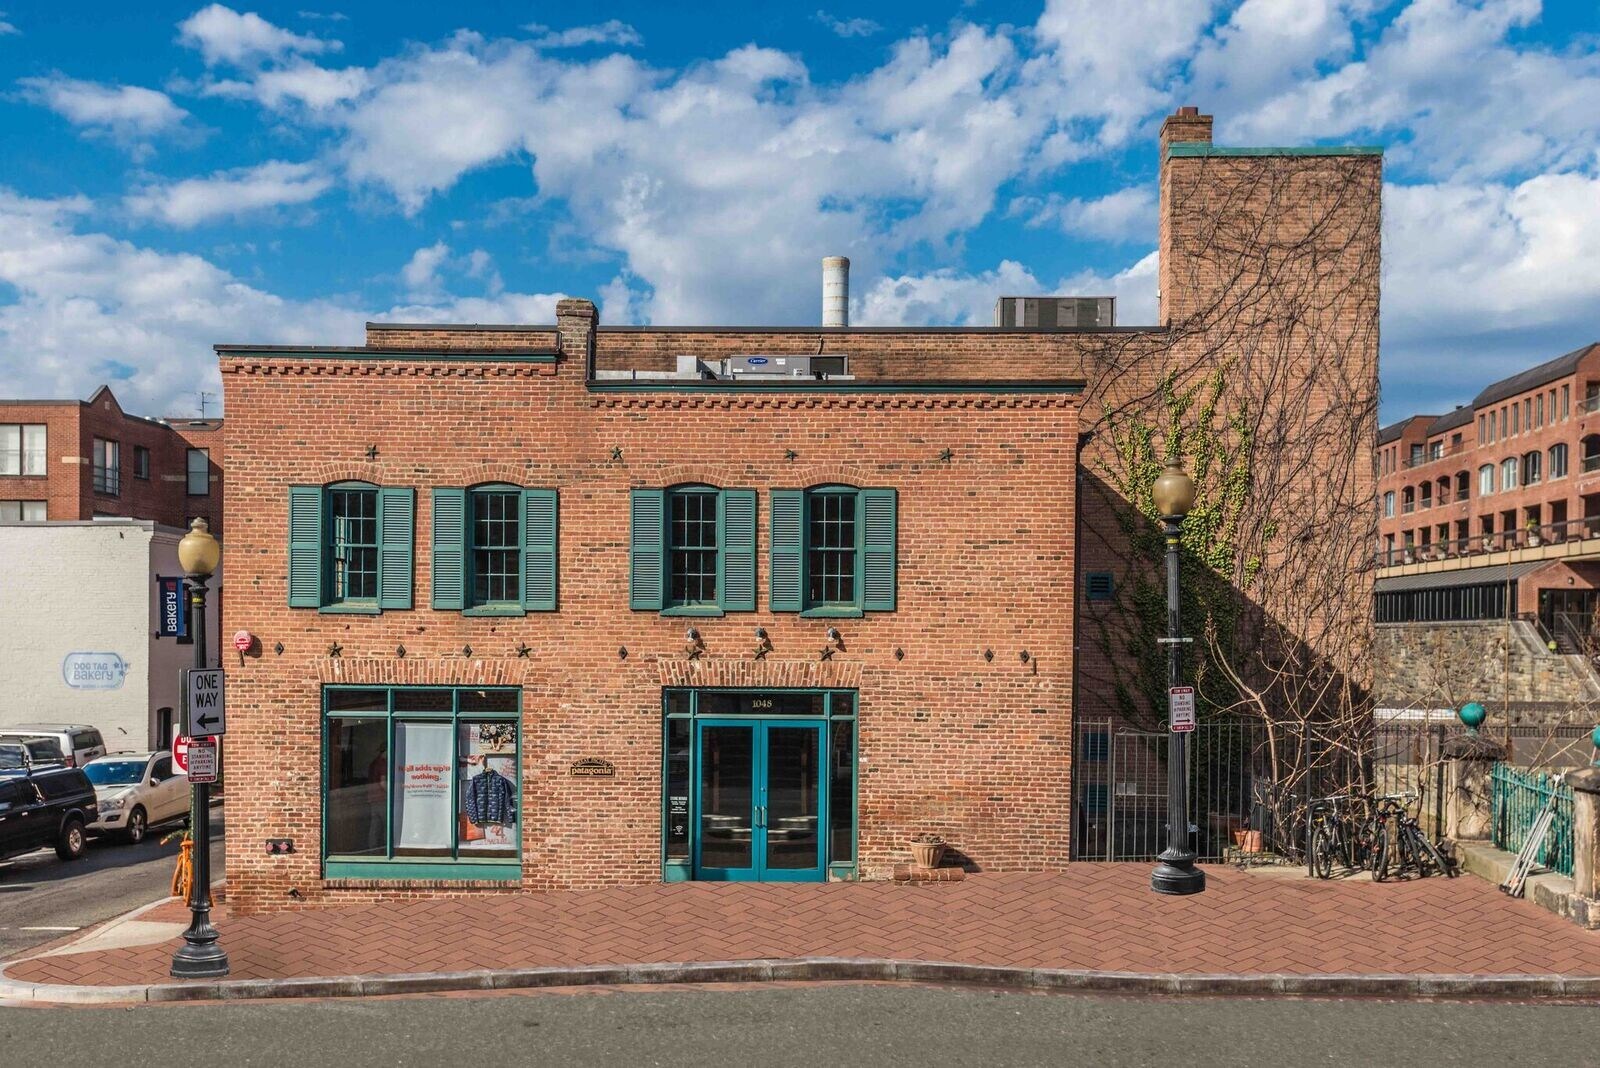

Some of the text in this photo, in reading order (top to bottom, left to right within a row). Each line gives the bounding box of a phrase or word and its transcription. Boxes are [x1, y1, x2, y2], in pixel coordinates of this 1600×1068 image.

[167, 592, 177, 632] Bakery
[74, 662, 108, 670] DOG TAG
[74, 670, 113, 680] Bakery
[196, 674, 218, 689] ONE
[195, 692, 219, 708] WAY
[752, 699, 772, 708] 1048
[571, 767, 612, 775] patagonia
